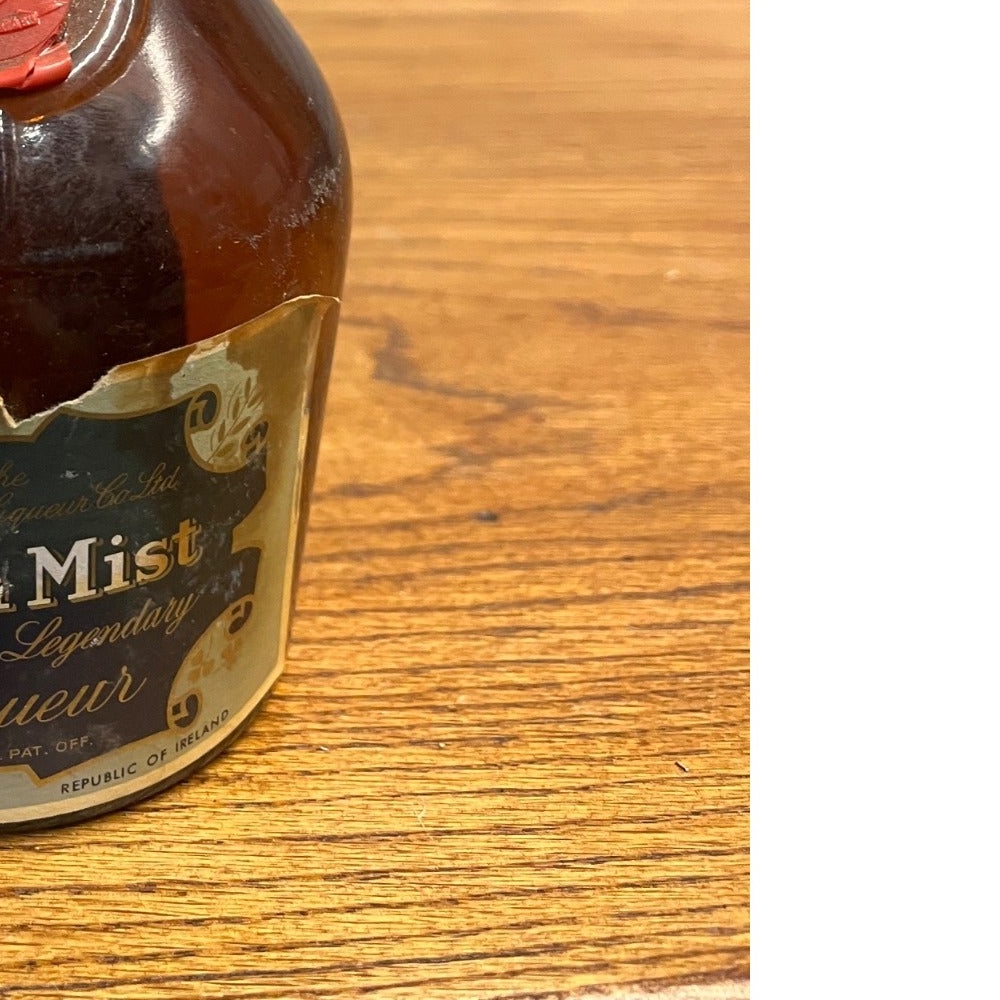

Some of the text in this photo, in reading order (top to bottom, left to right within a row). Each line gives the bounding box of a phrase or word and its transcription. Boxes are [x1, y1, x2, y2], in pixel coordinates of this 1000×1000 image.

[27, 518, 202, 609] Mist
[0, 590, 200, 669] Legendary
[9, 746, 48, 760] PAT.
[56, 735, 95, 753] OFF.
[61, 708, 230, 795] REPUBLIC OF IRELAND
